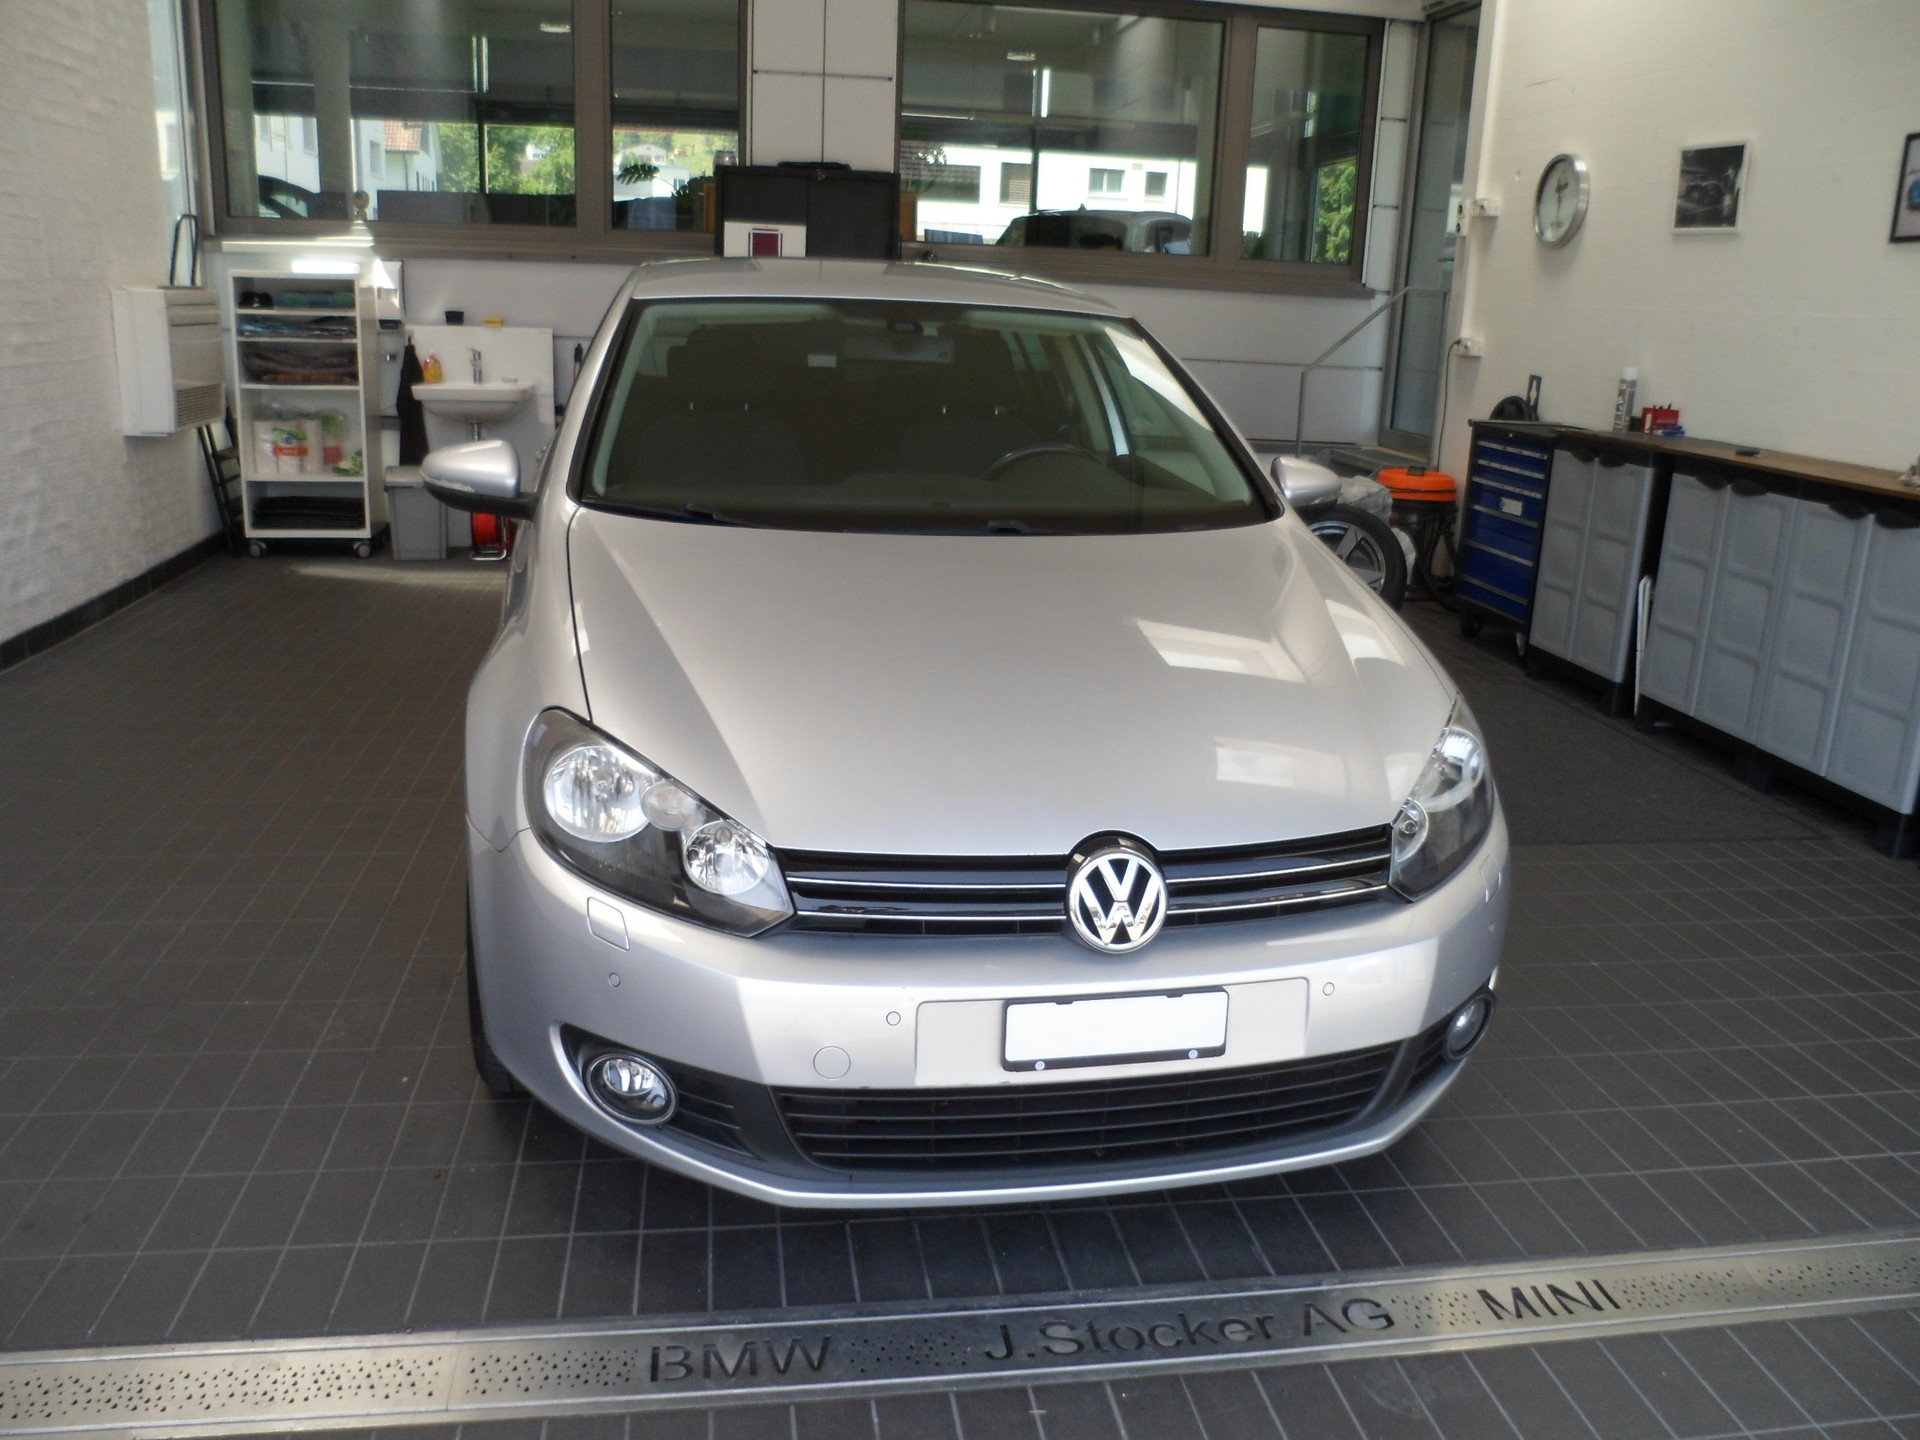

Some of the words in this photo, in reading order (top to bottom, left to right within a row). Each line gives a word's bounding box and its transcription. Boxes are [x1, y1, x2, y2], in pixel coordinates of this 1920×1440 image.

[1072, 854, 1166, 950] VW
[1476, 1279, 1621, 1321] MINI
[984, 1312, 1275, 1361] J.Stocker
[1303, 1298, 1396, 1337] AG
[649, 1335, 832, 1382] BMW
